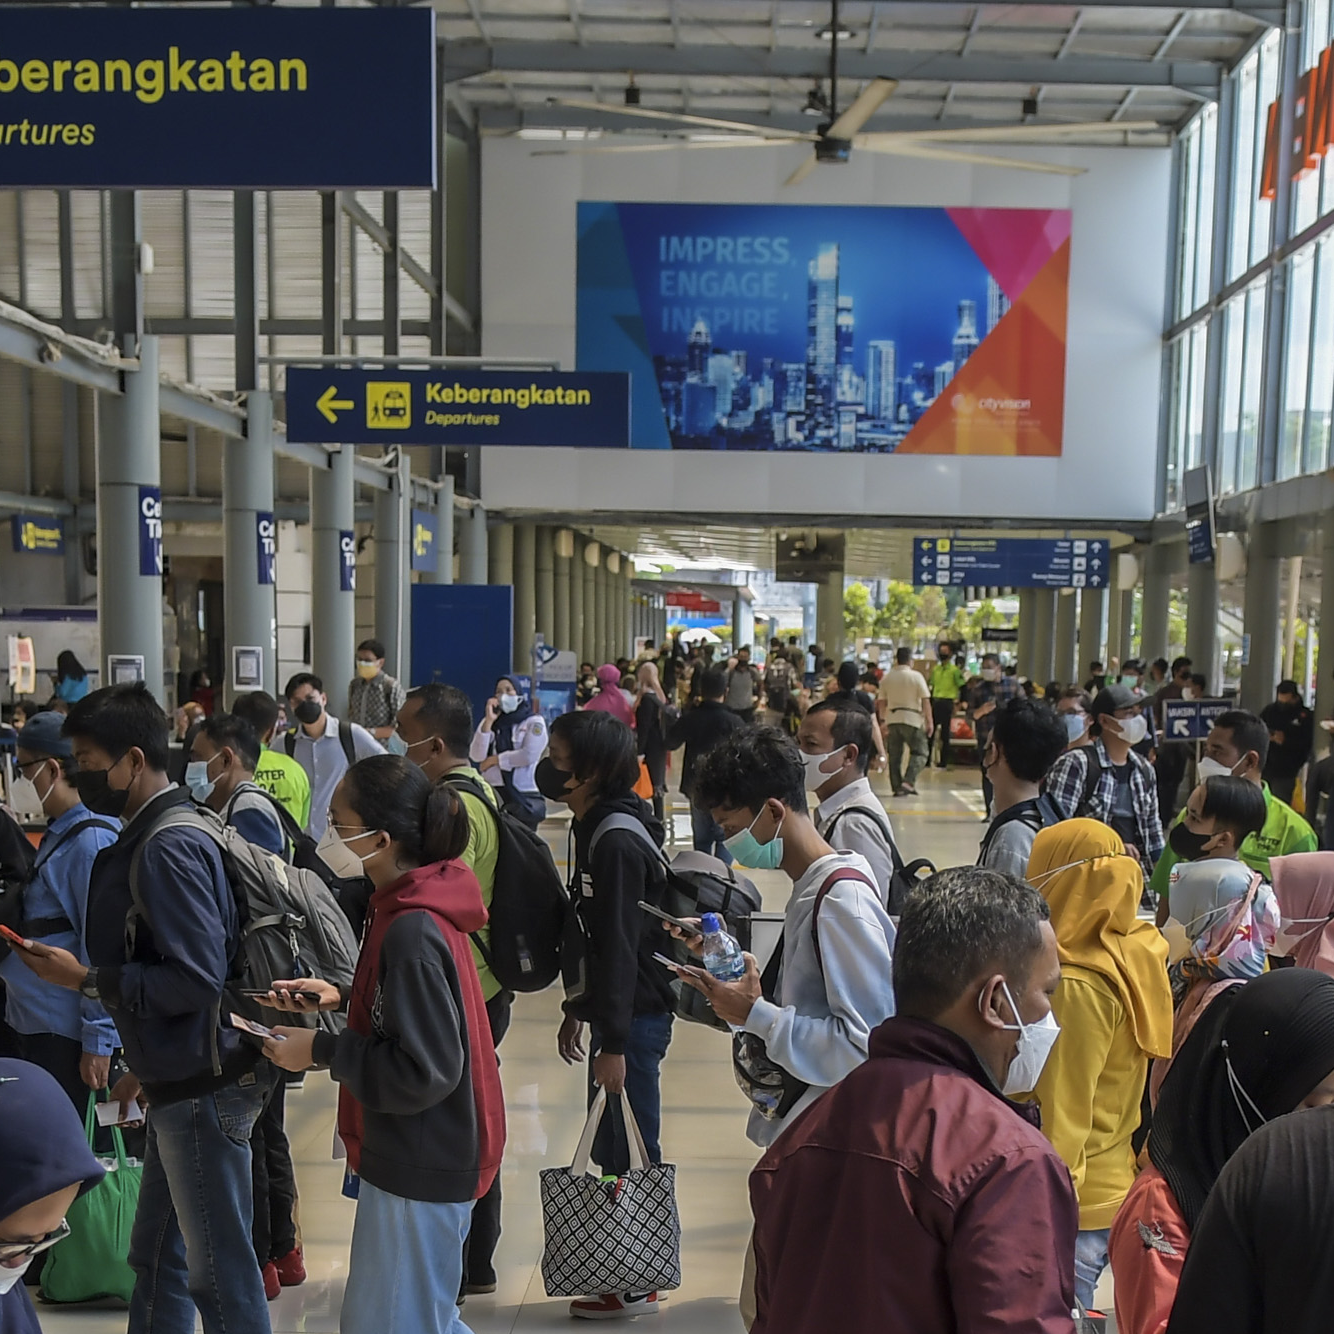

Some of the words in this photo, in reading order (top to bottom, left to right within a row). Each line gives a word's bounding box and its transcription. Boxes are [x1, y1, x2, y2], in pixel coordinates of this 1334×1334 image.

[659, 236, 797, 266] IMPRESS,
[659, 270, 790, 302] ENGAGE,
[661, 306, 780, 334] INSPIRE
[425, 382, 591, 409] Keberangkatan
[425, 410, 500, 427] Departures
